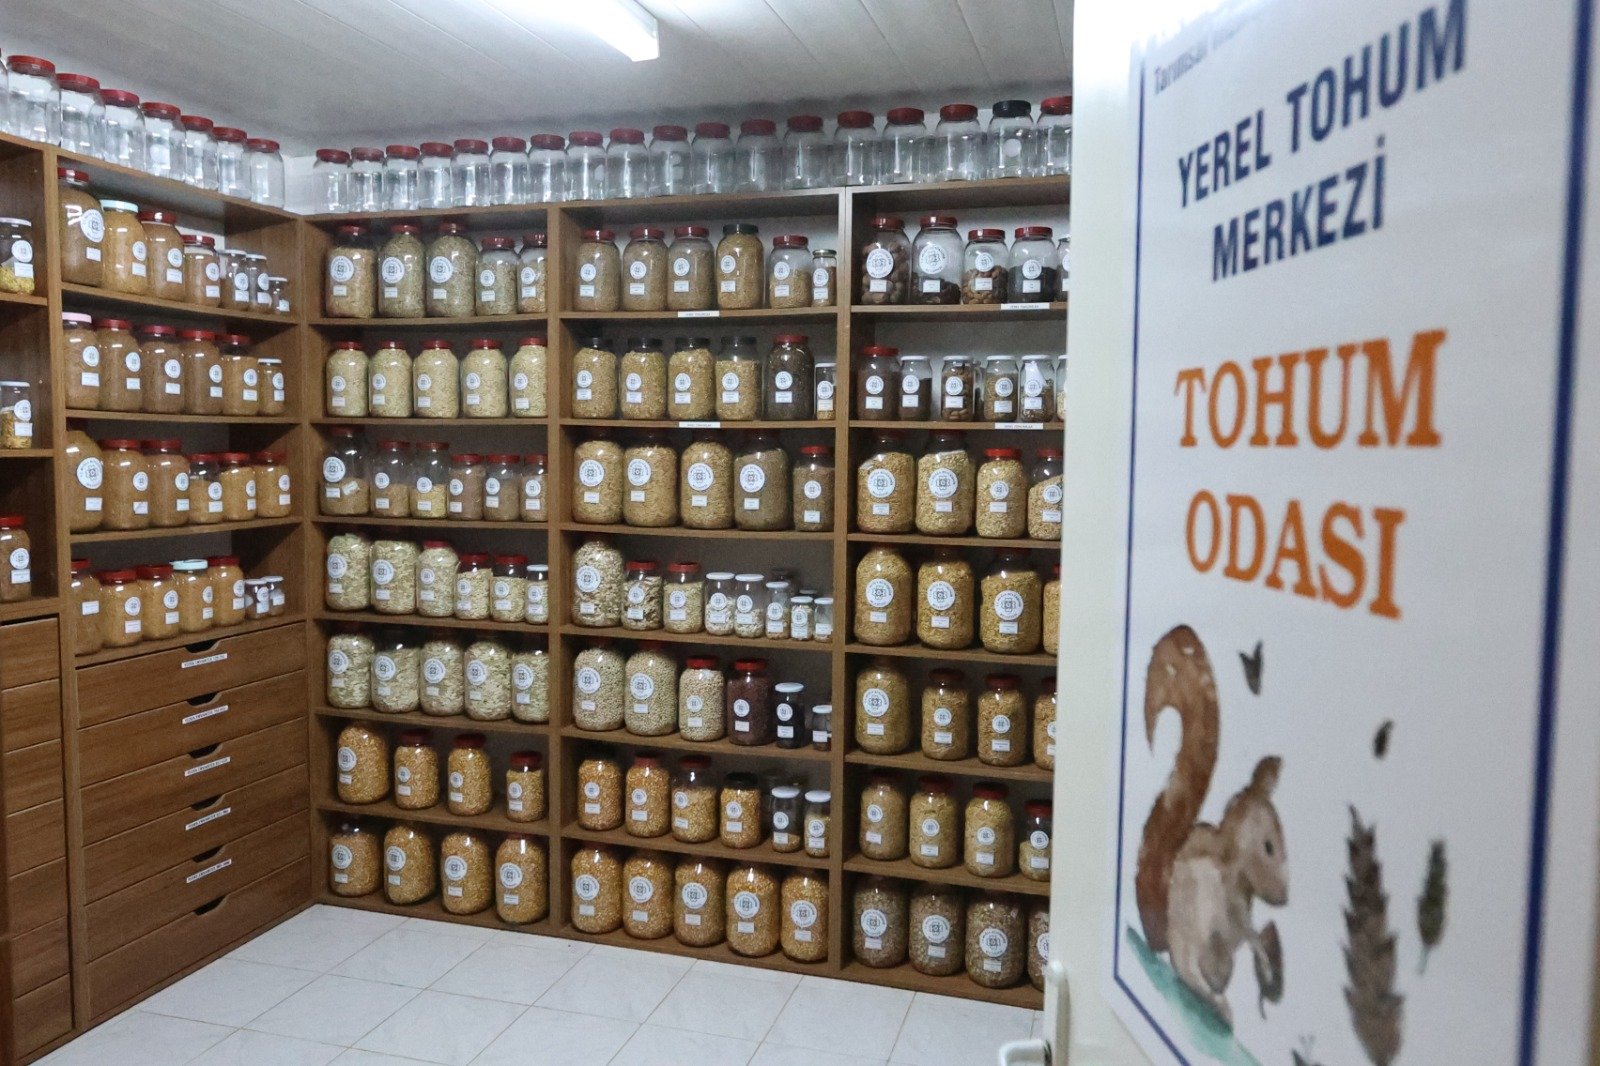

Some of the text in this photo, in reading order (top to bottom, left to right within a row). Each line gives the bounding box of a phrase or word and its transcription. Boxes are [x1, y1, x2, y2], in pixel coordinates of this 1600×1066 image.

[1177, 0, 1468, 209] YEREL TOHUM
[1211, 135, 1386, 282] MERKEZİ
[1174, 329, 1447, 450] TOHUM
[1186, 489, 1406, 620] ODASI
